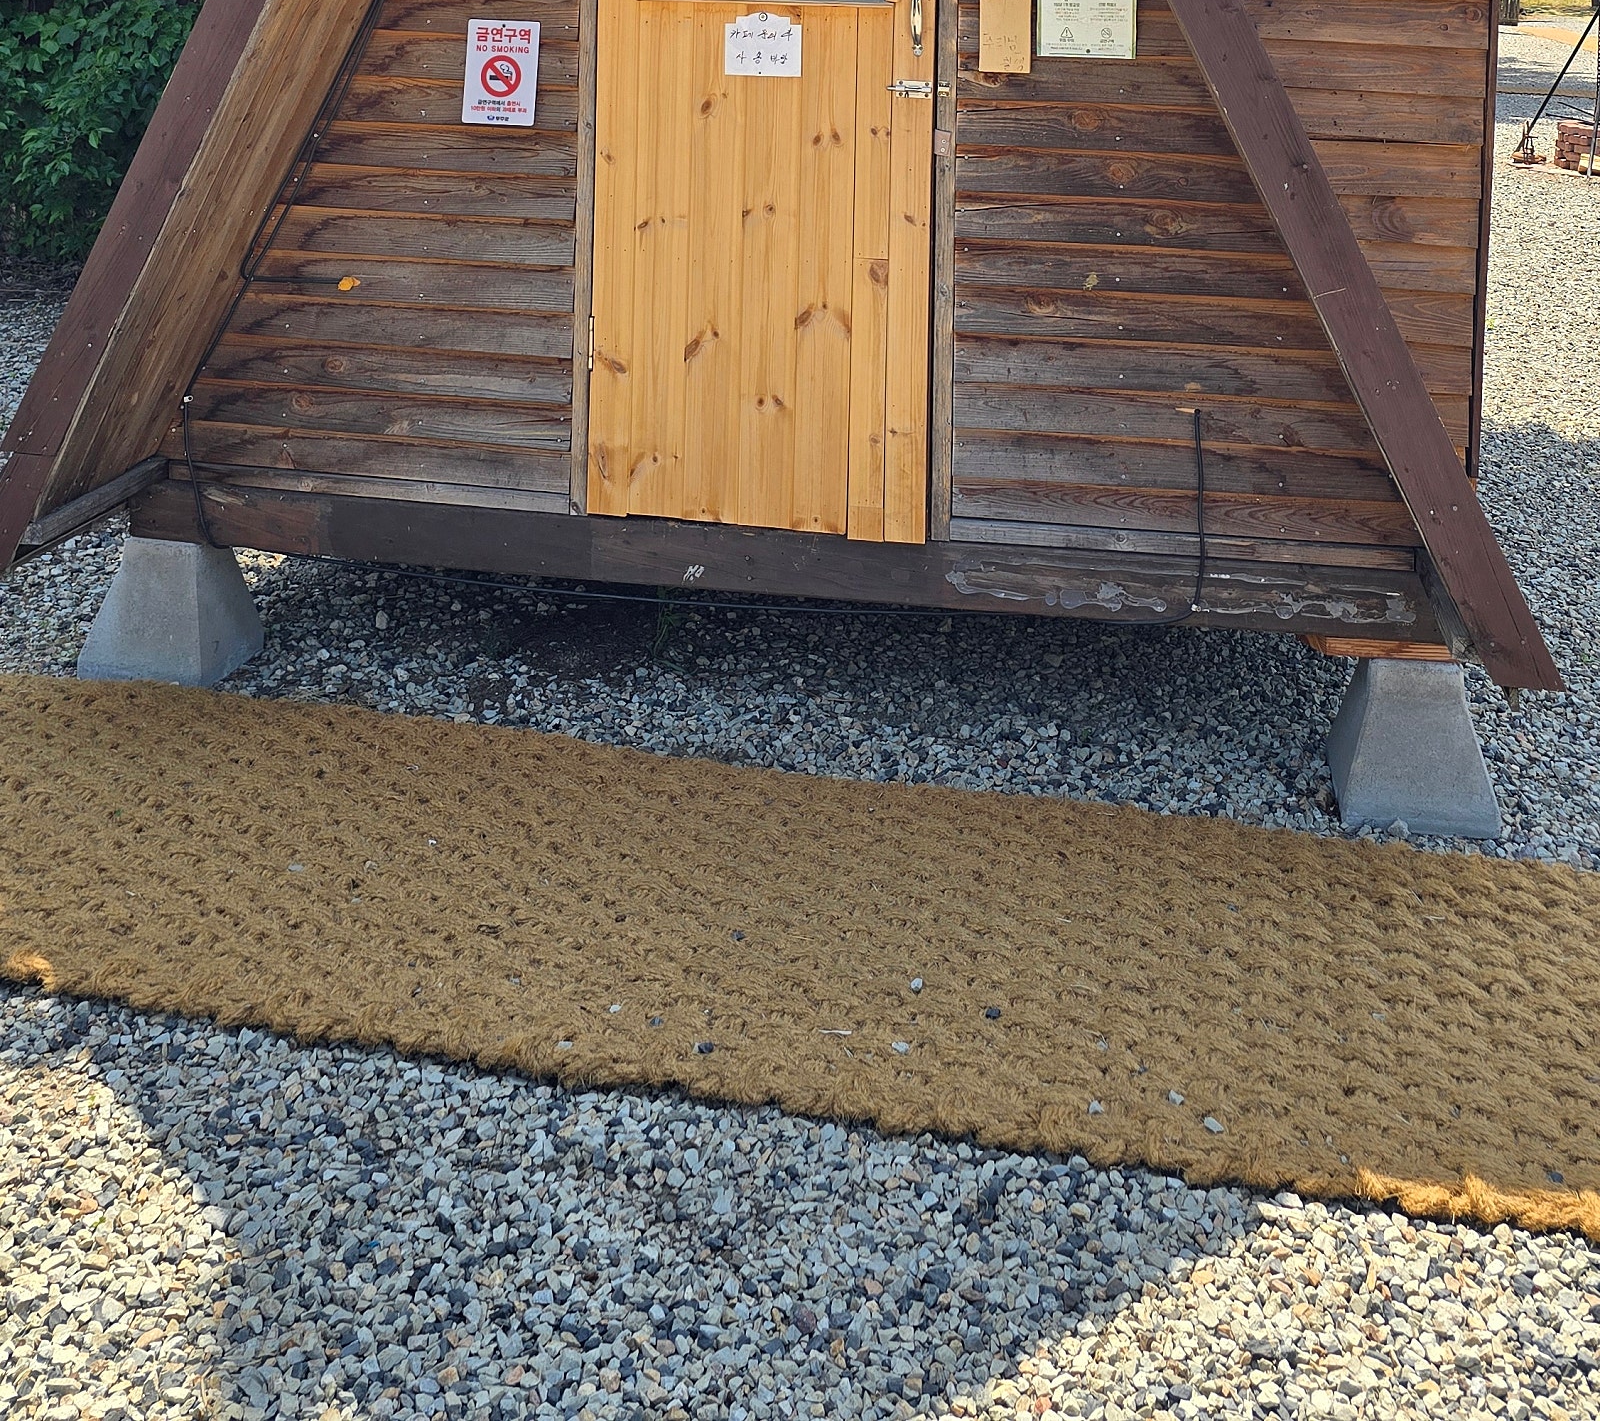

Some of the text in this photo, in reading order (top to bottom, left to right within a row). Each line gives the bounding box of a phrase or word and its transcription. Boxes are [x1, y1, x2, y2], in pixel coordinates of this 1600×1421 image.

[475, 26, 532, 45] 금연구역
[475, 44, 530, 54] NO SMOKING
